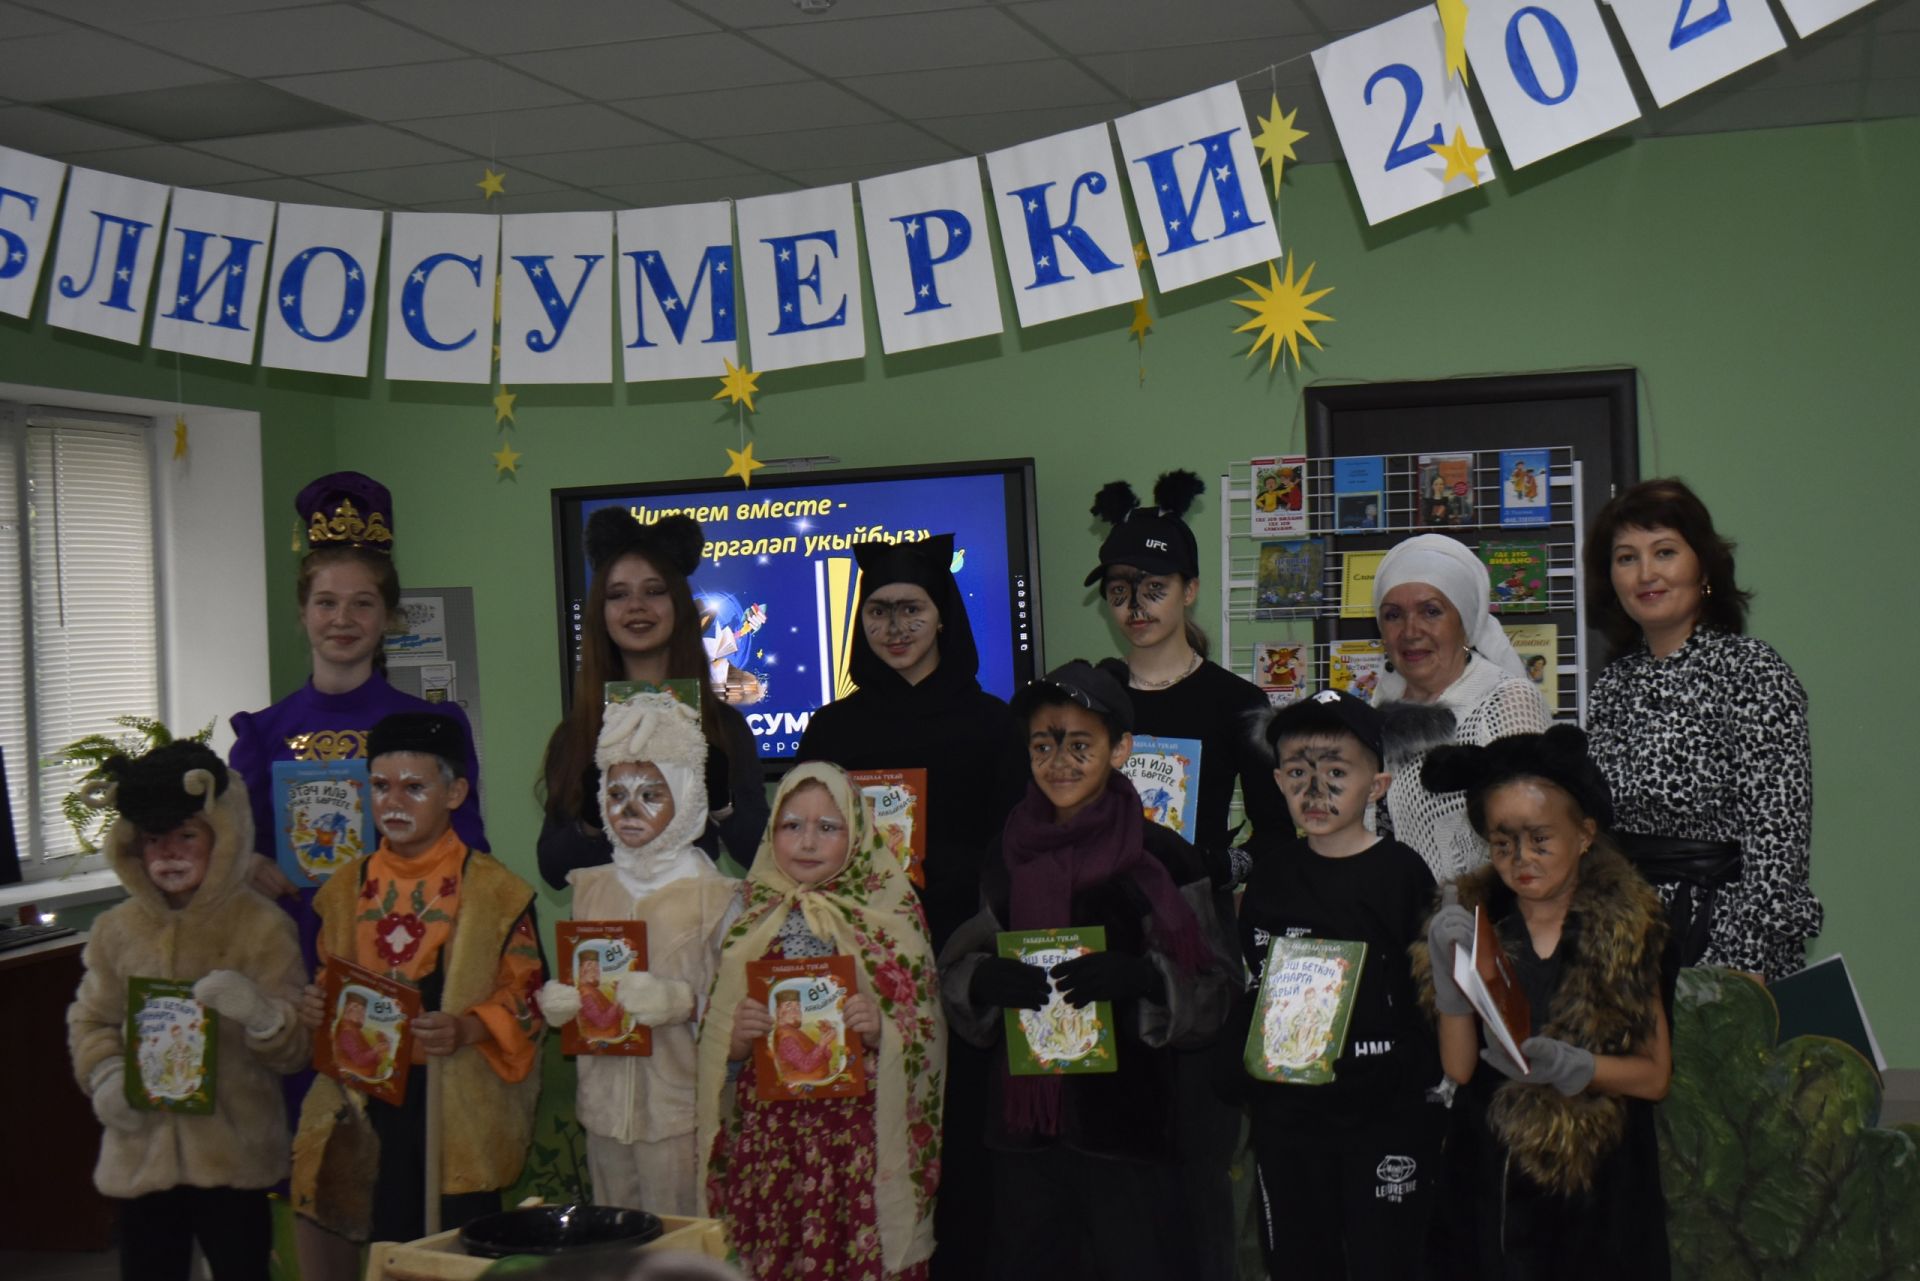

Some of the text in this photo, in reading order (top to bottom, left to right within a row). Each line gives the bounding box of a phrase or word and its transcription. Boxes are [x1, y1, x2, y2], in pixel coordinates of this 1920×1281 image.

[735, 498, 832, 521] вместе
[702, 537, 797, 562] ергәләп
[1145, 538, 1168, 552] UFC
[745, 711, 816, 736] СУМ
